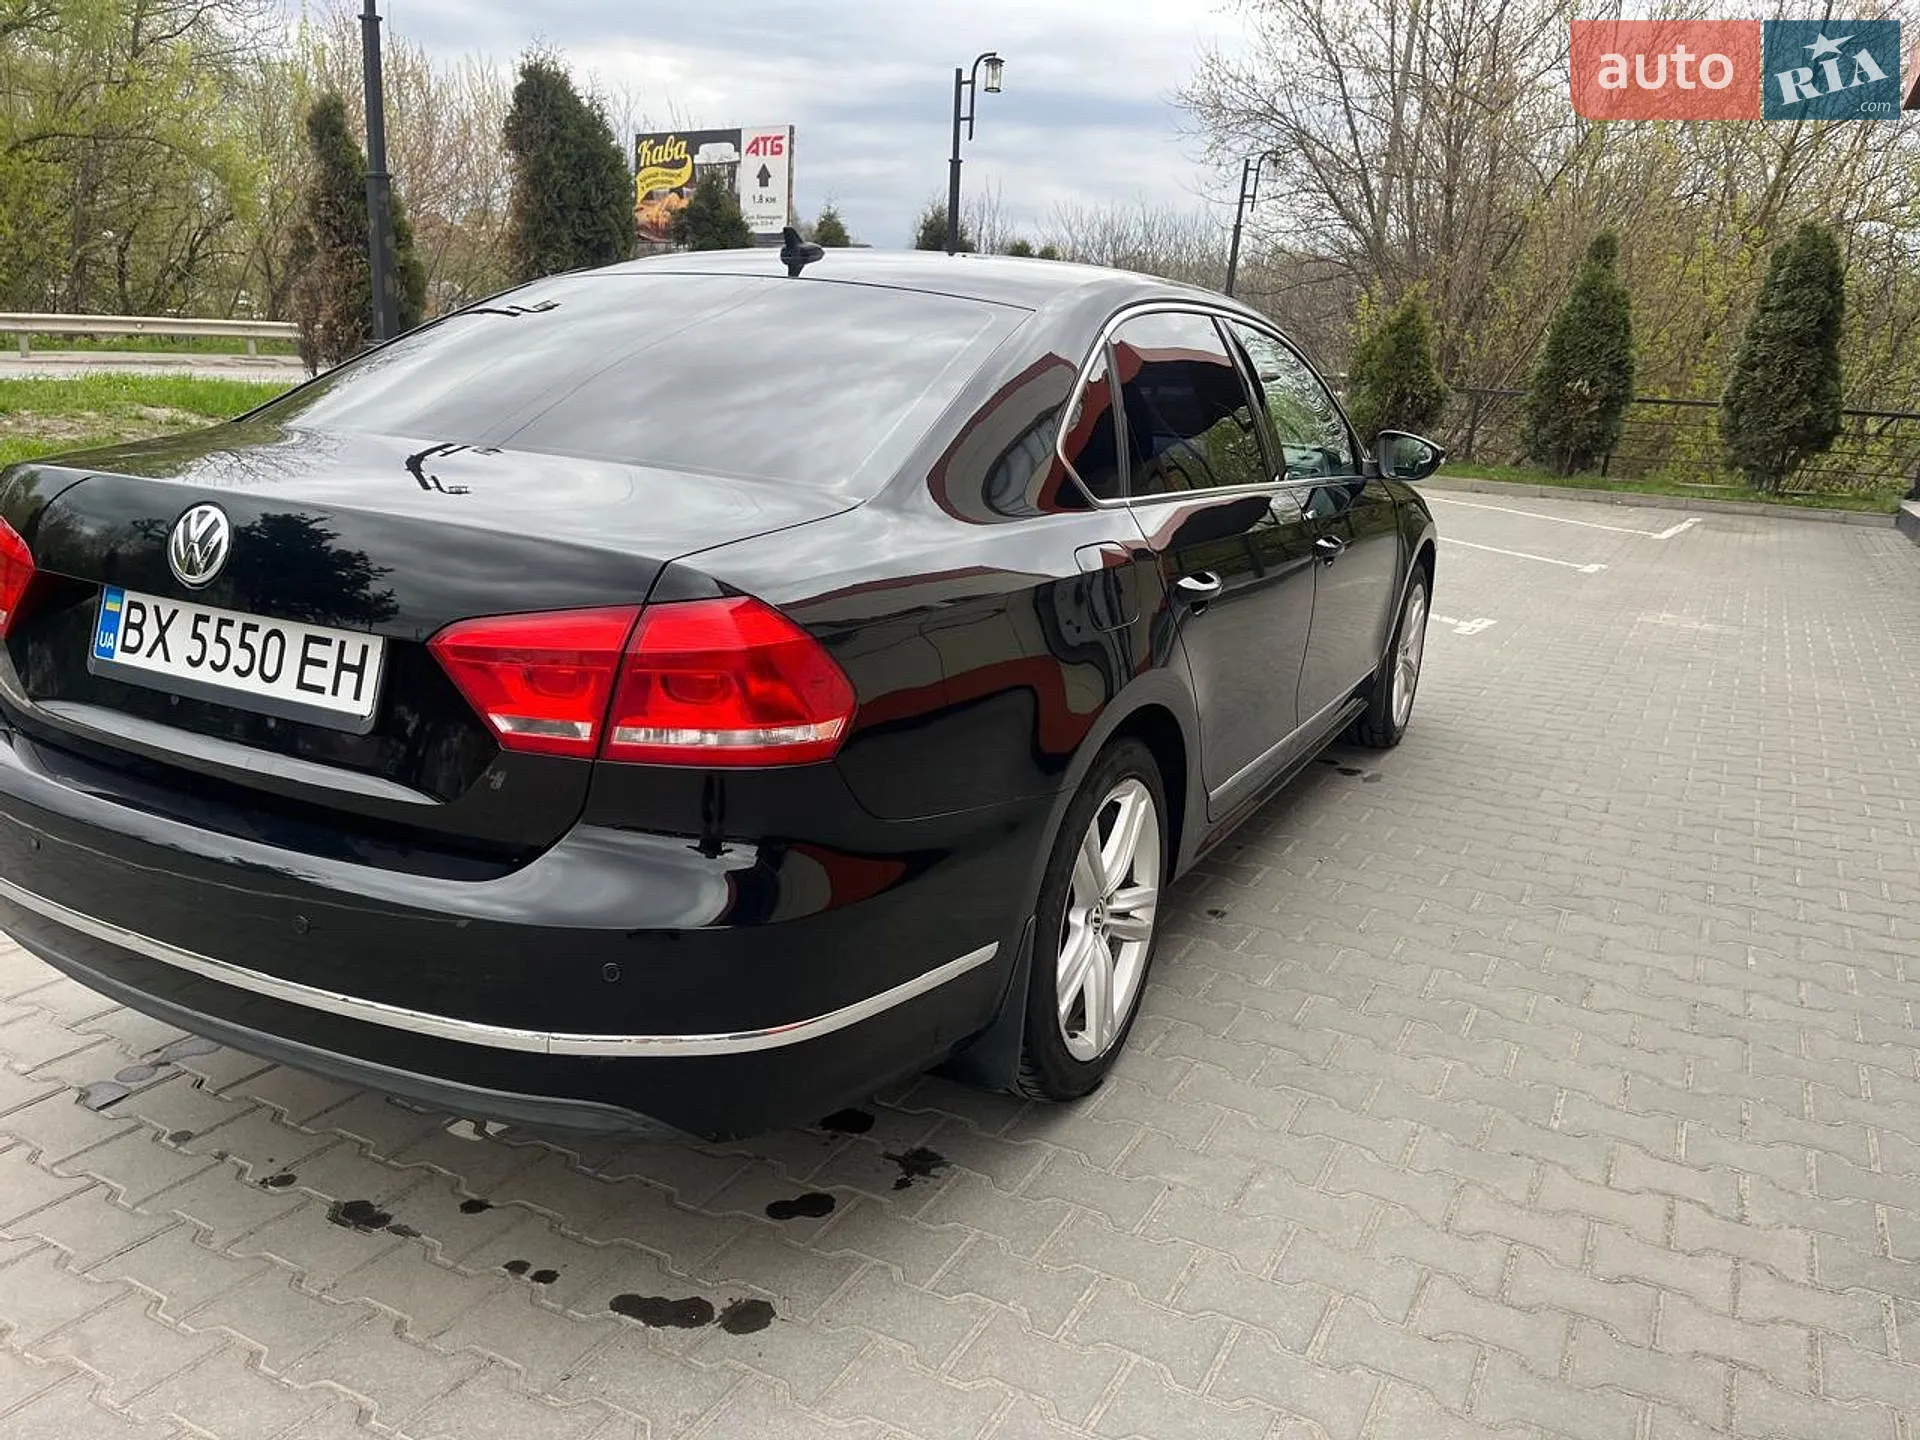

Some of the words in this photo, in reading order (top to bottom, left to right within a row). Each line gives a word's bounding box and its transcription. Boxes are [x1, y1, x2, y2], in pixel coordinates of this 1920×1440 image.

[638, 135, 688, 167] Кава
[99, 632, 114, 648] UA
[120, 600, 180, 662] BX
[186, 613, 286, 684] 5550
[296, 633, 370, 702] EH
